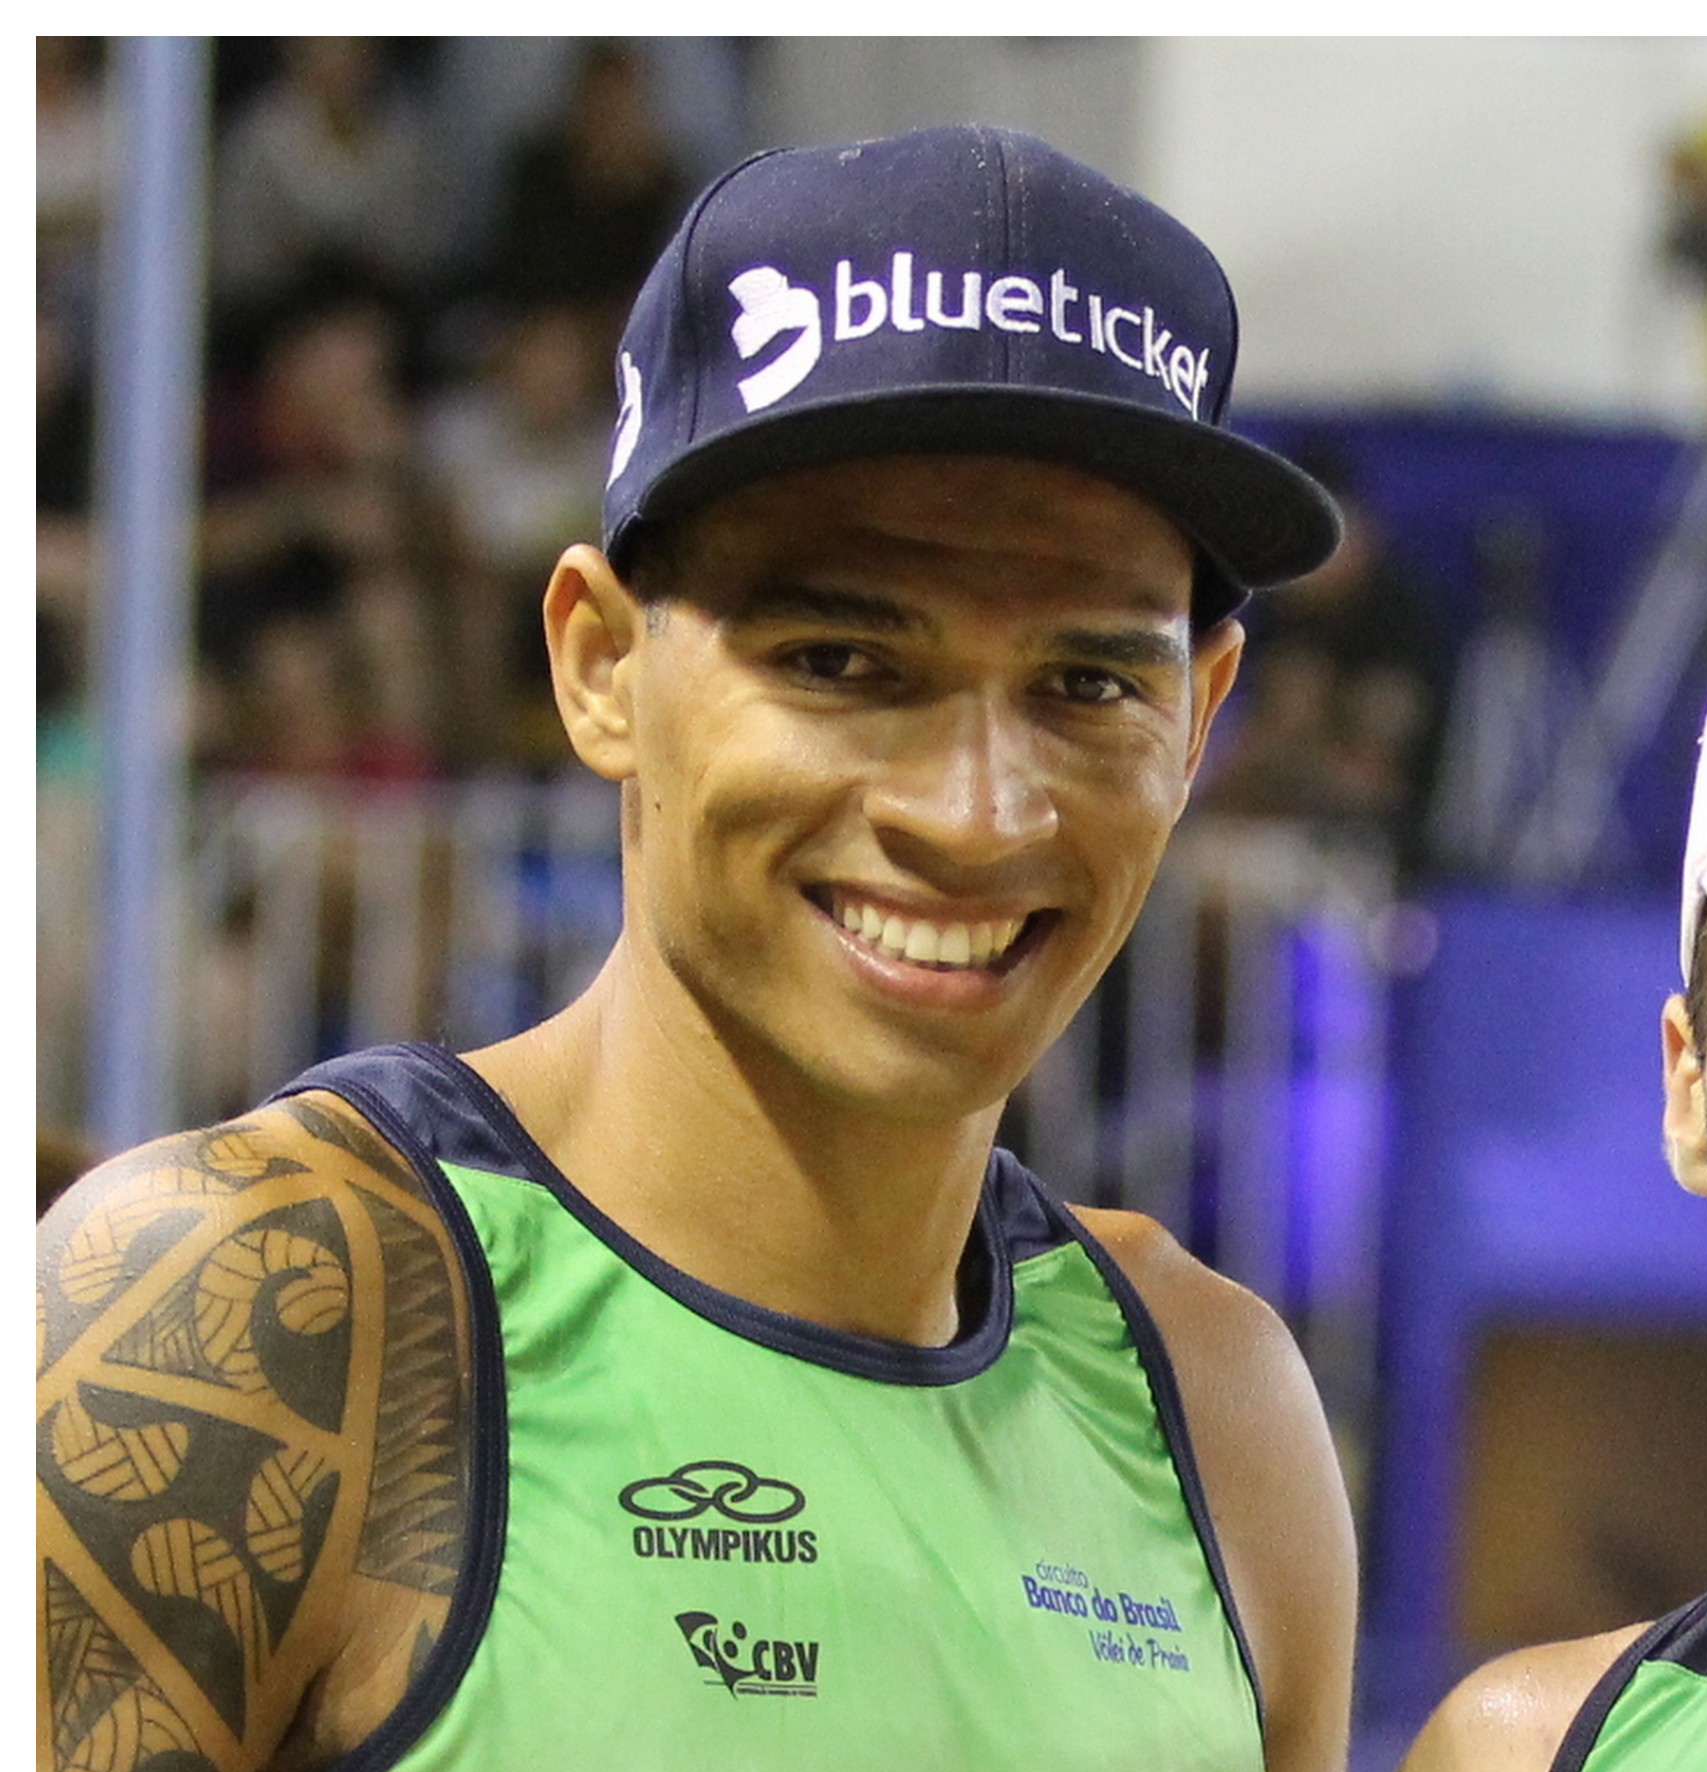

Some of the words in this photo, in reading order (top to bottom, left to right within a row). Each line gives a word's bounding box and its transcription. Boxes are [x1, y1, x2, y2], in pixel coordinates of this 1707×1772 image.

[835, 252, 1210, 422] blueticket
[633, 1527, 817, 1564] OLYMPIKUS
[1022, 1575, 1088, 1617] Banco
[1091, 1586, 1118, 1622] do
[1119, 1592, 1181, 1631] Brasil
[752, 1640, 819, 1682] CBV
[1126, 1632, 1145, 1665] de
[1146, 1638, 1190, 1672] Praia
